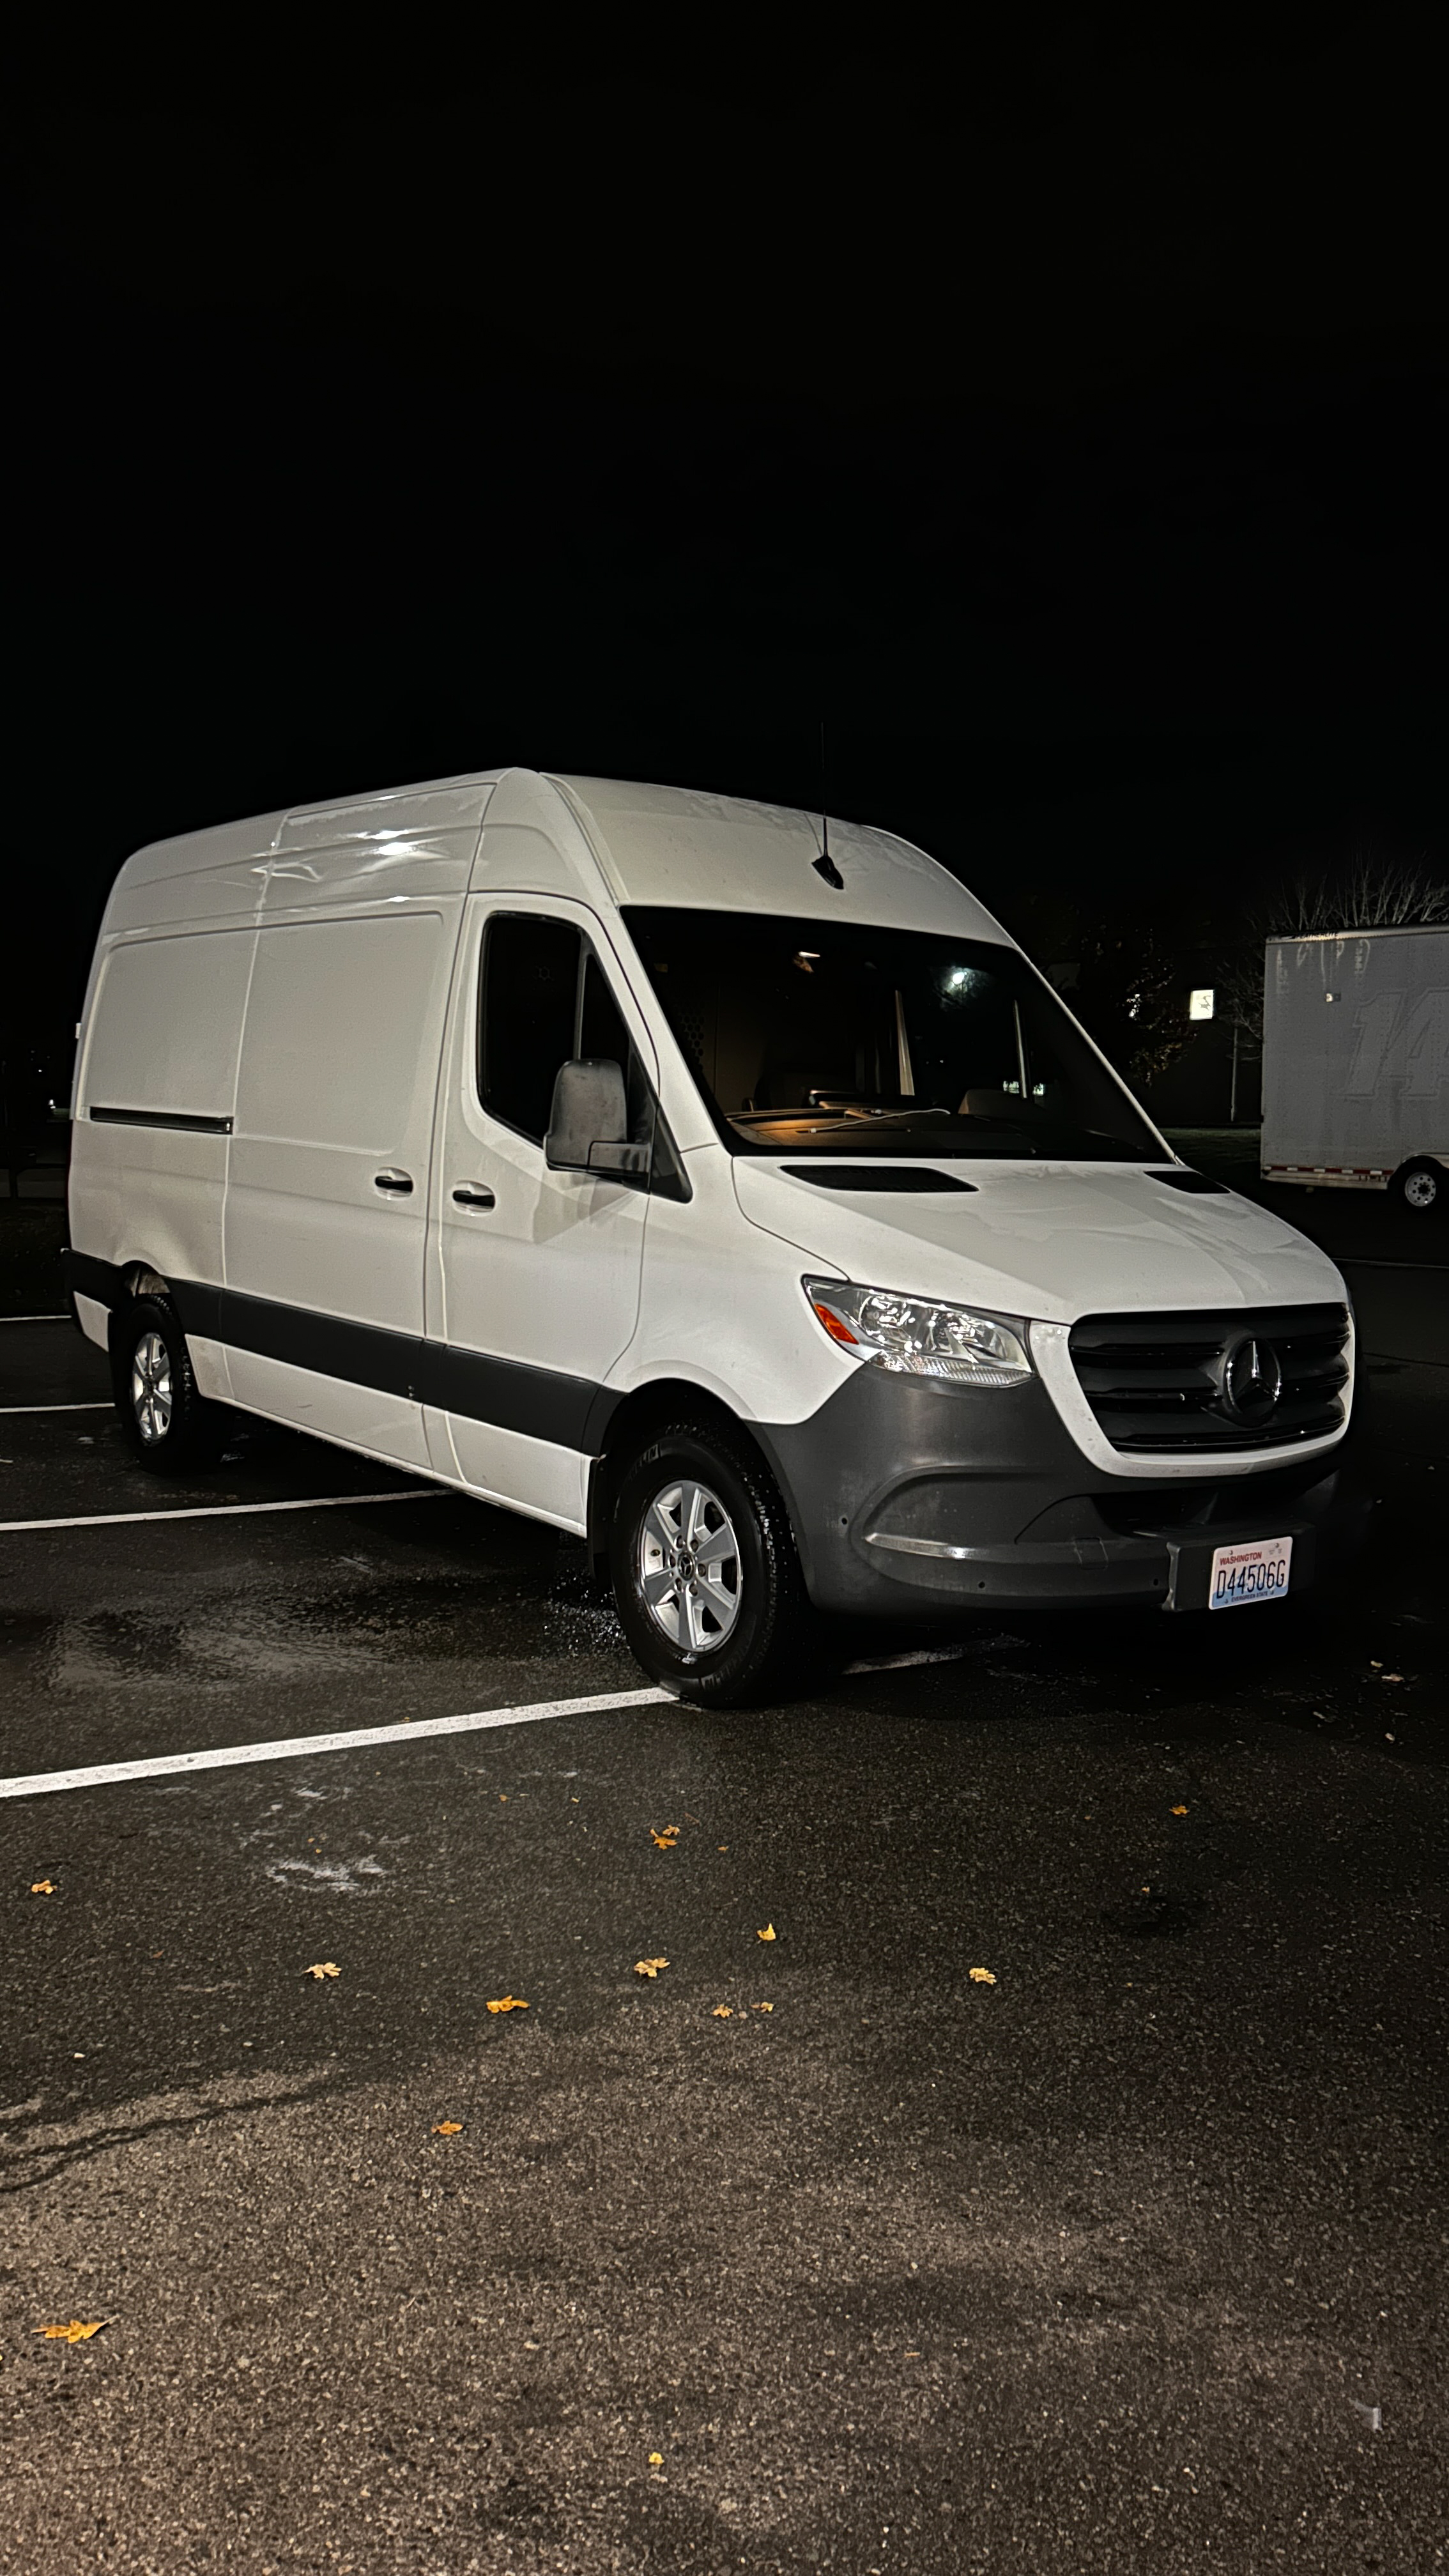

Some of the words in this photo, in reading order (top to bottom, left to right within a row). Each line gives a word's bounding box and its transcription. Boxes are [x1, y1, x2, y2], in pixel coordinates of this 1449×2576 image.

[1220, 1552, 1262, 1566] WASHINGTON
[1216, 1560, 1286, 1599] D44506G
[1231, 1593, 1256, 1602] EVERGREEN
